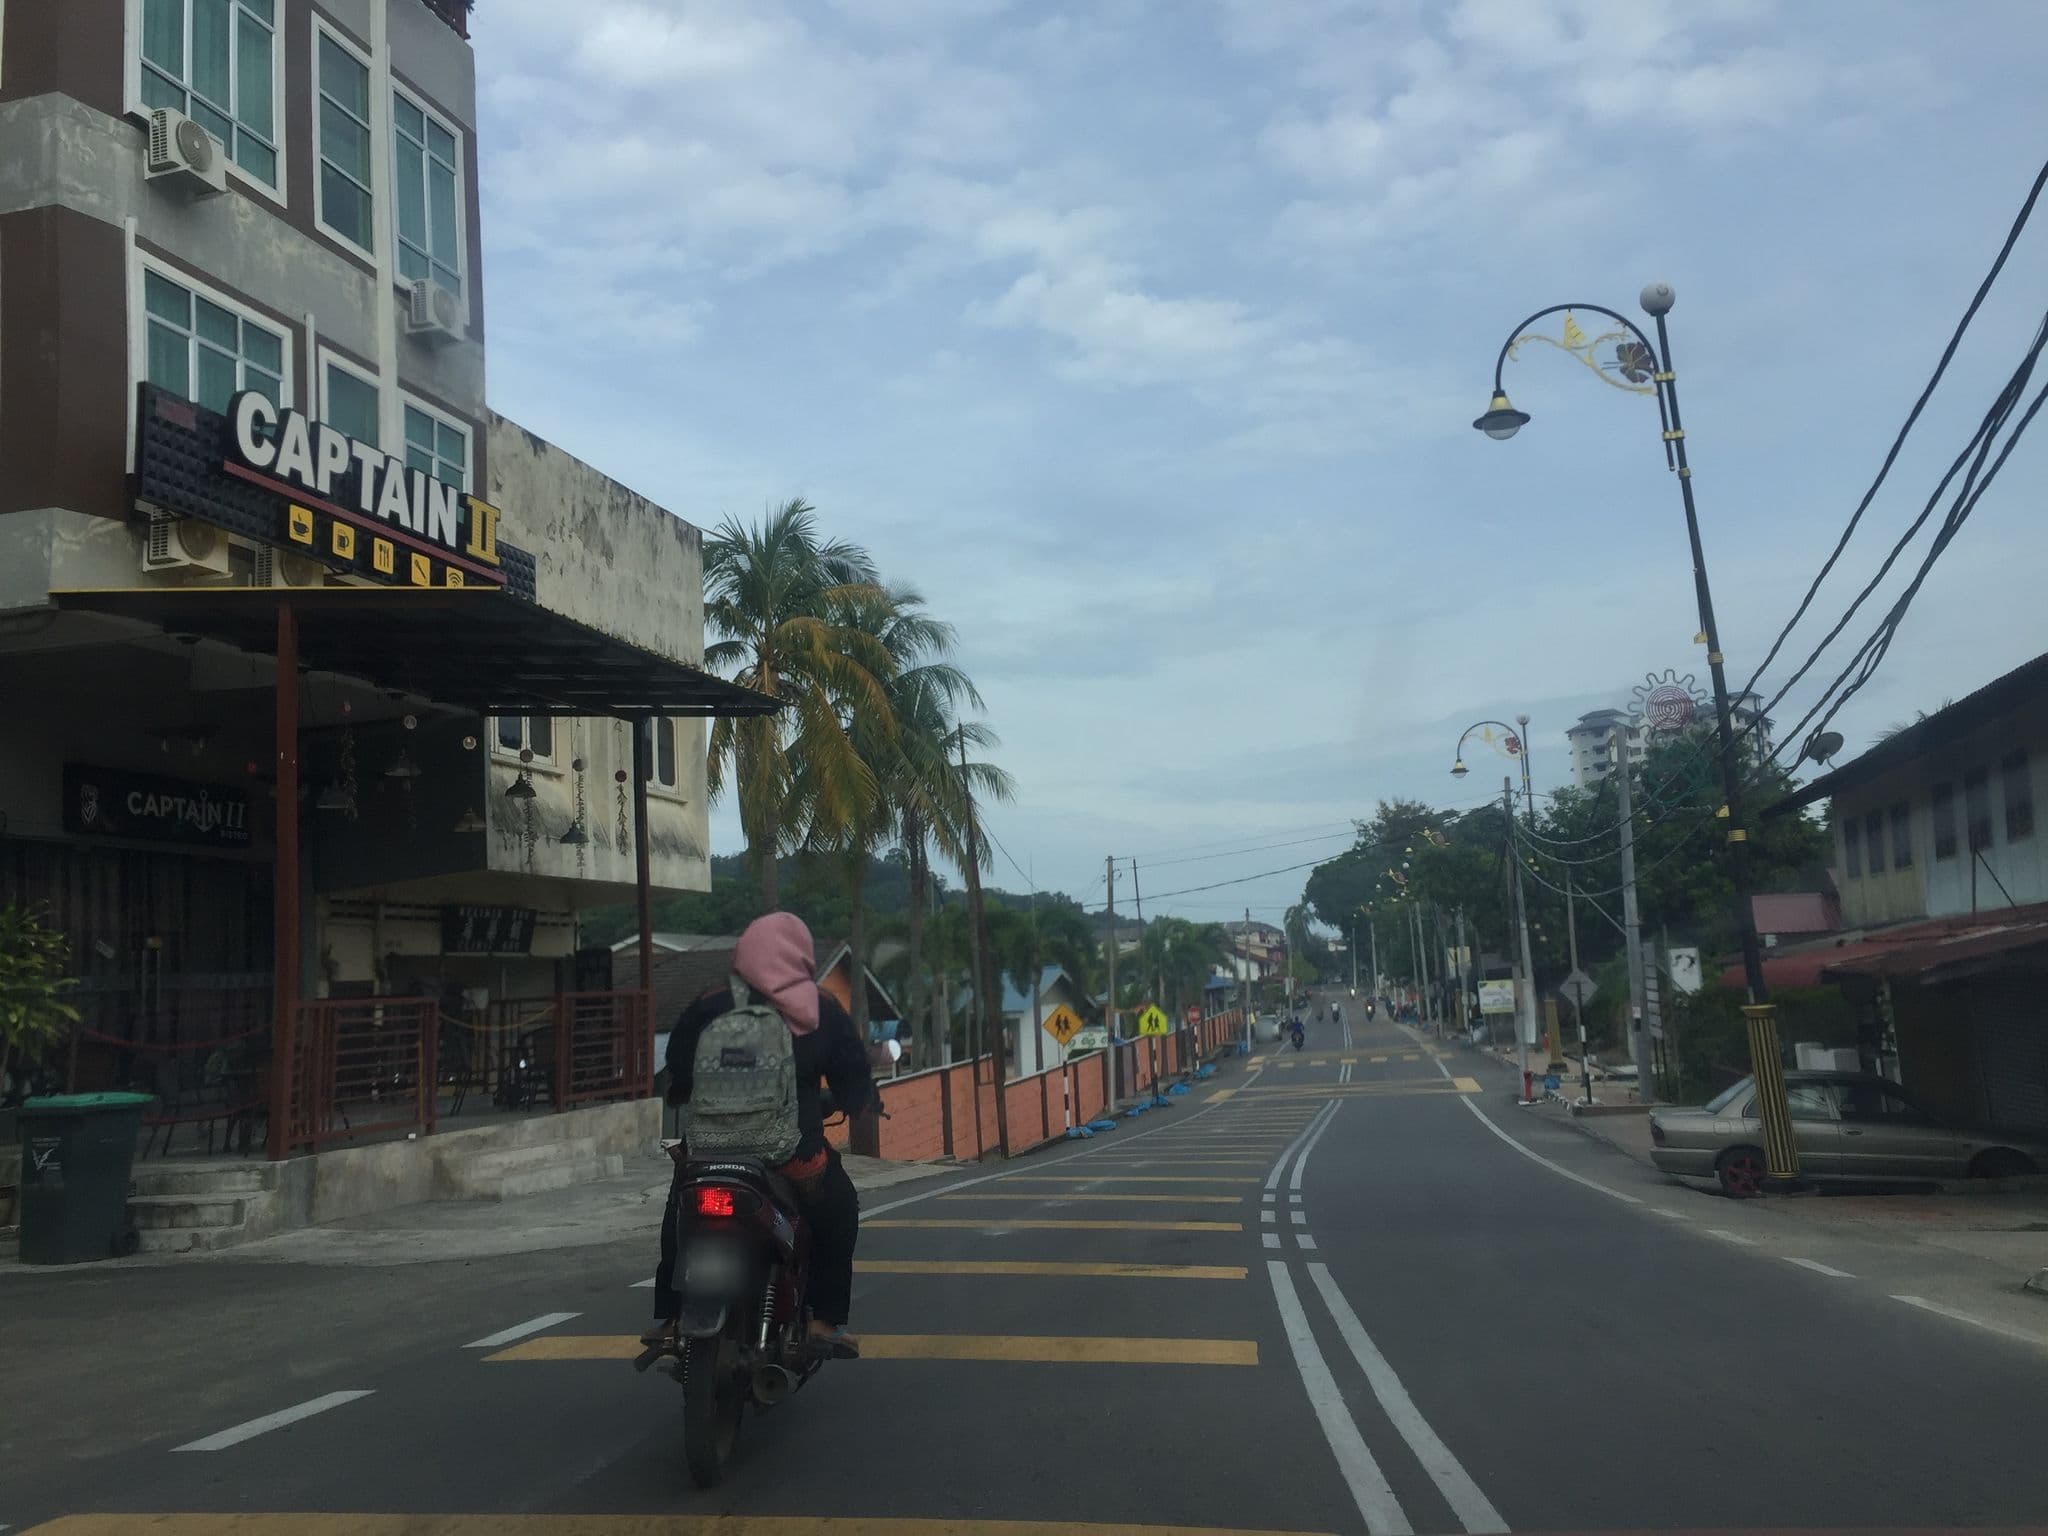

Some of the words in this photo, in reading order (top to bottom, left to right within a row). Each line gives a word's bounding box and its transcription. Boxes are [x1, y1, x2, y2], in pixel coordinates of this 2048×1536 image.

[233, 390, 457, 548] CAPTAIN
[464, 495, 500, 566] II
[127, 790, 222, 831] CAPTAIN
[227, 801, 246, 828] II
